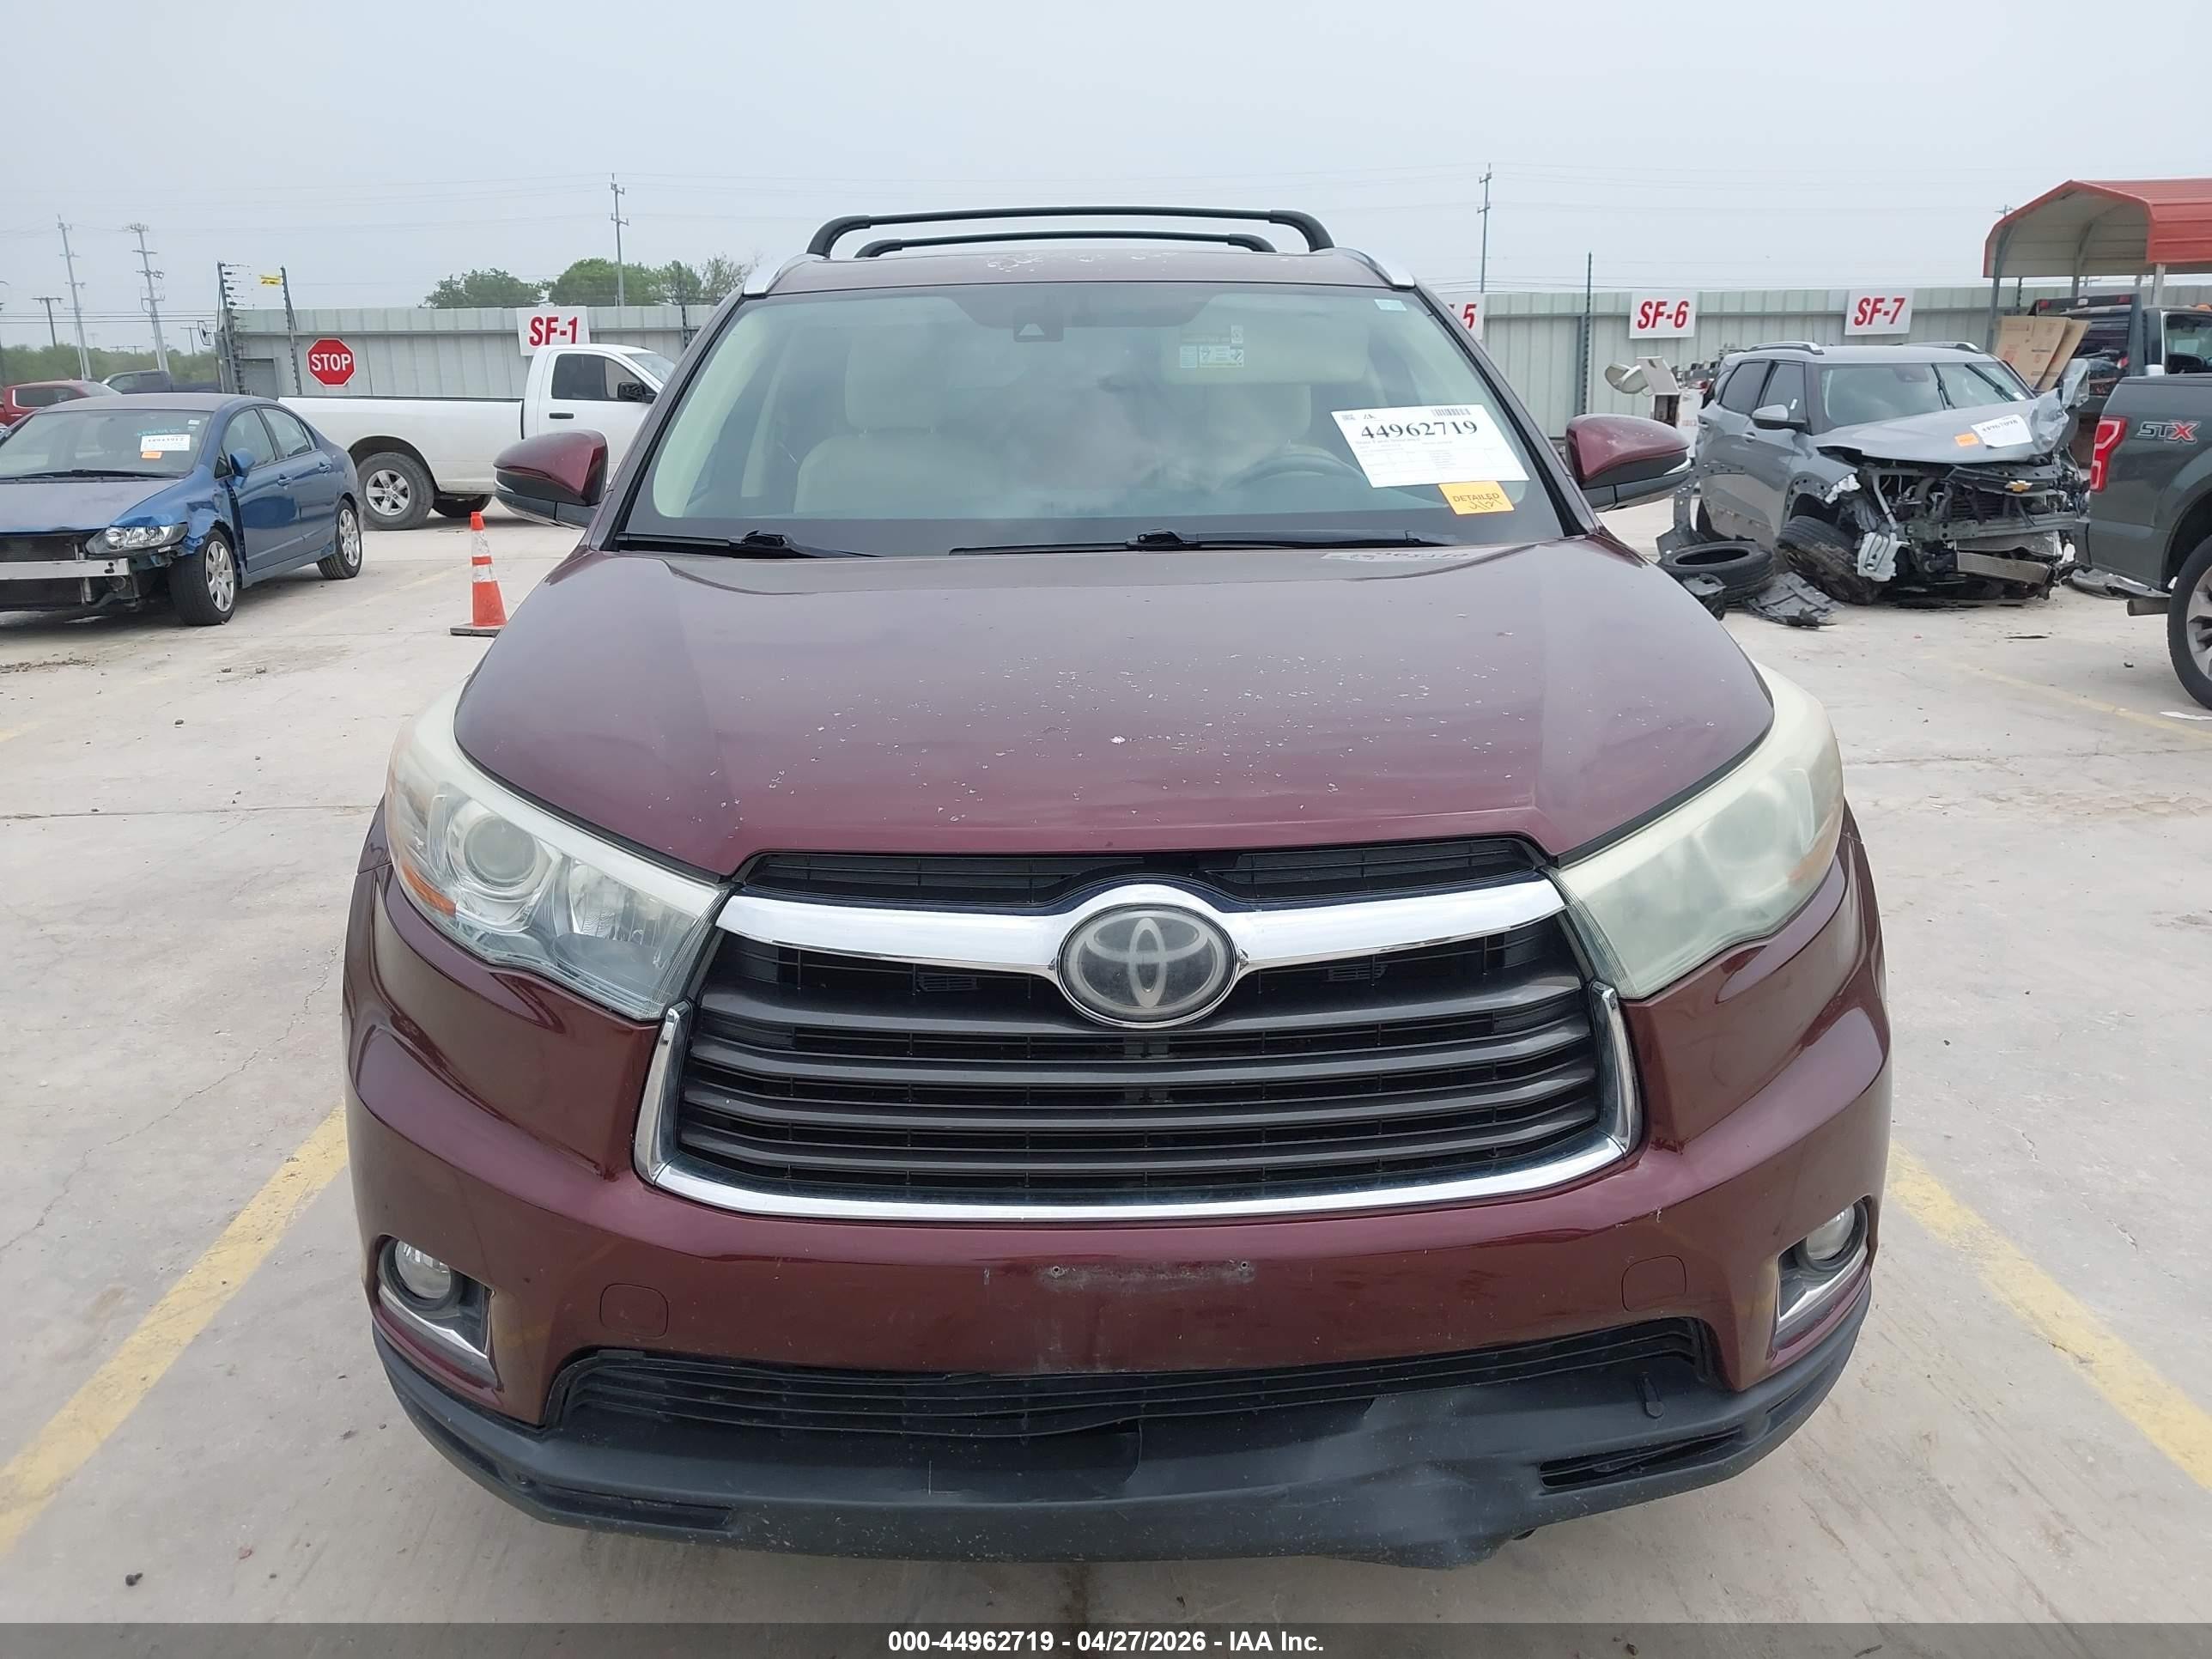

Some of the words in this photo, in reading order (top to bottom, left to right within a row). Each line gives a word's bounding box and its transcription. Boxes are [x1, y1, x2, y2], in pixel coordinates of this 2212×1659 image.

[1638, 301, 1689, 329] SF-6
[1854, 297, 1905, 325] SF-7
[529, 316, 578, 346] SF-1
[311, 353, 351, 371] STOP
[1361, 420, 1478, 439] 44962719
[2135, 420, 2201, 445] STX
[1453, 492, 1500, 502] DETAILED
